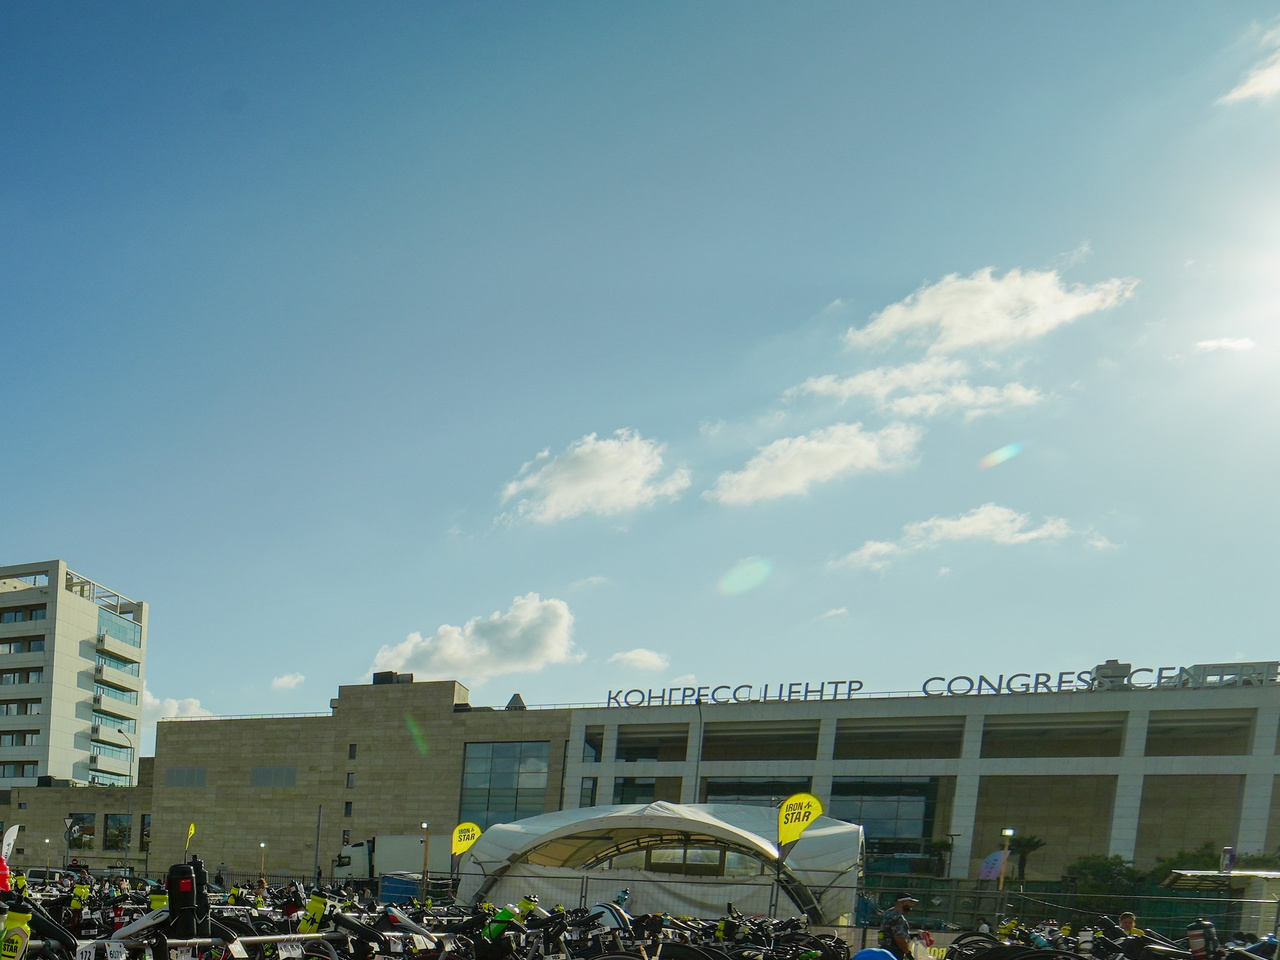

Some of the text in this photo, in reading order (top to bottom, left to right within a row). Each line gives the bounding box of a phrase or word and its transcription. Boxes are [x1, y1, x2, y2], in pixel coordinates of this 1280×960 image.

[922, 670, 1113, 697] CONGRESS
[607, 680, 864, 707] КОНГРЕСС ЦЕНТР
[785, 802, 803, 812] IRON
[783, 810, 811, 825] STAR
[458, 833, 475, 842] STAR
[2, 943, 18, 953] STAR
[80, 950, 91, 960] 172
